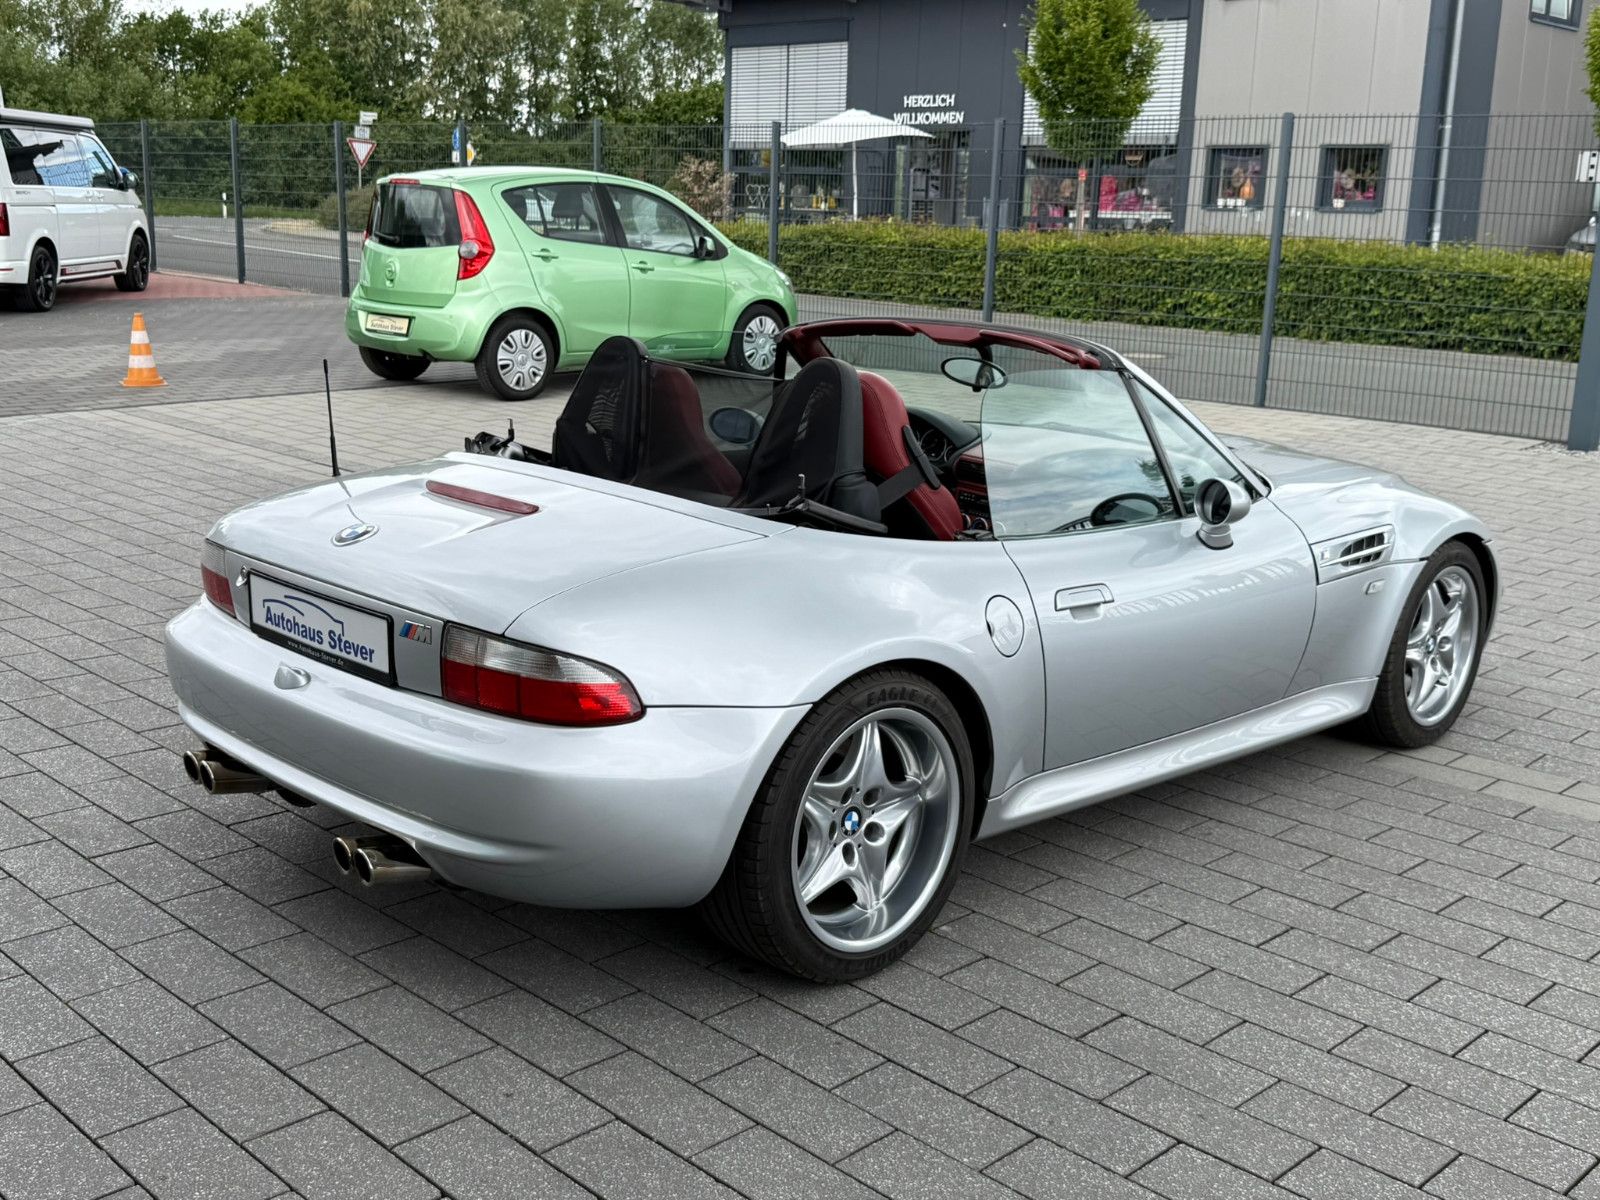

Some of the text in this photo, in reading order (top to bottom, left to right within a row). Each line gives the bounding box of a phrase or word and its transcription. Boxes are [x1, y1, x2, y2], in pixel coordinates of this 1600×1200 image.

[903, 93, 956, 108] HERZLICH
[893, 111, 965, 125] WILLKOMMEN
[265, 605, 375, 663] Autohaus Stever
[866, 686, 919, 707] EAGLE
